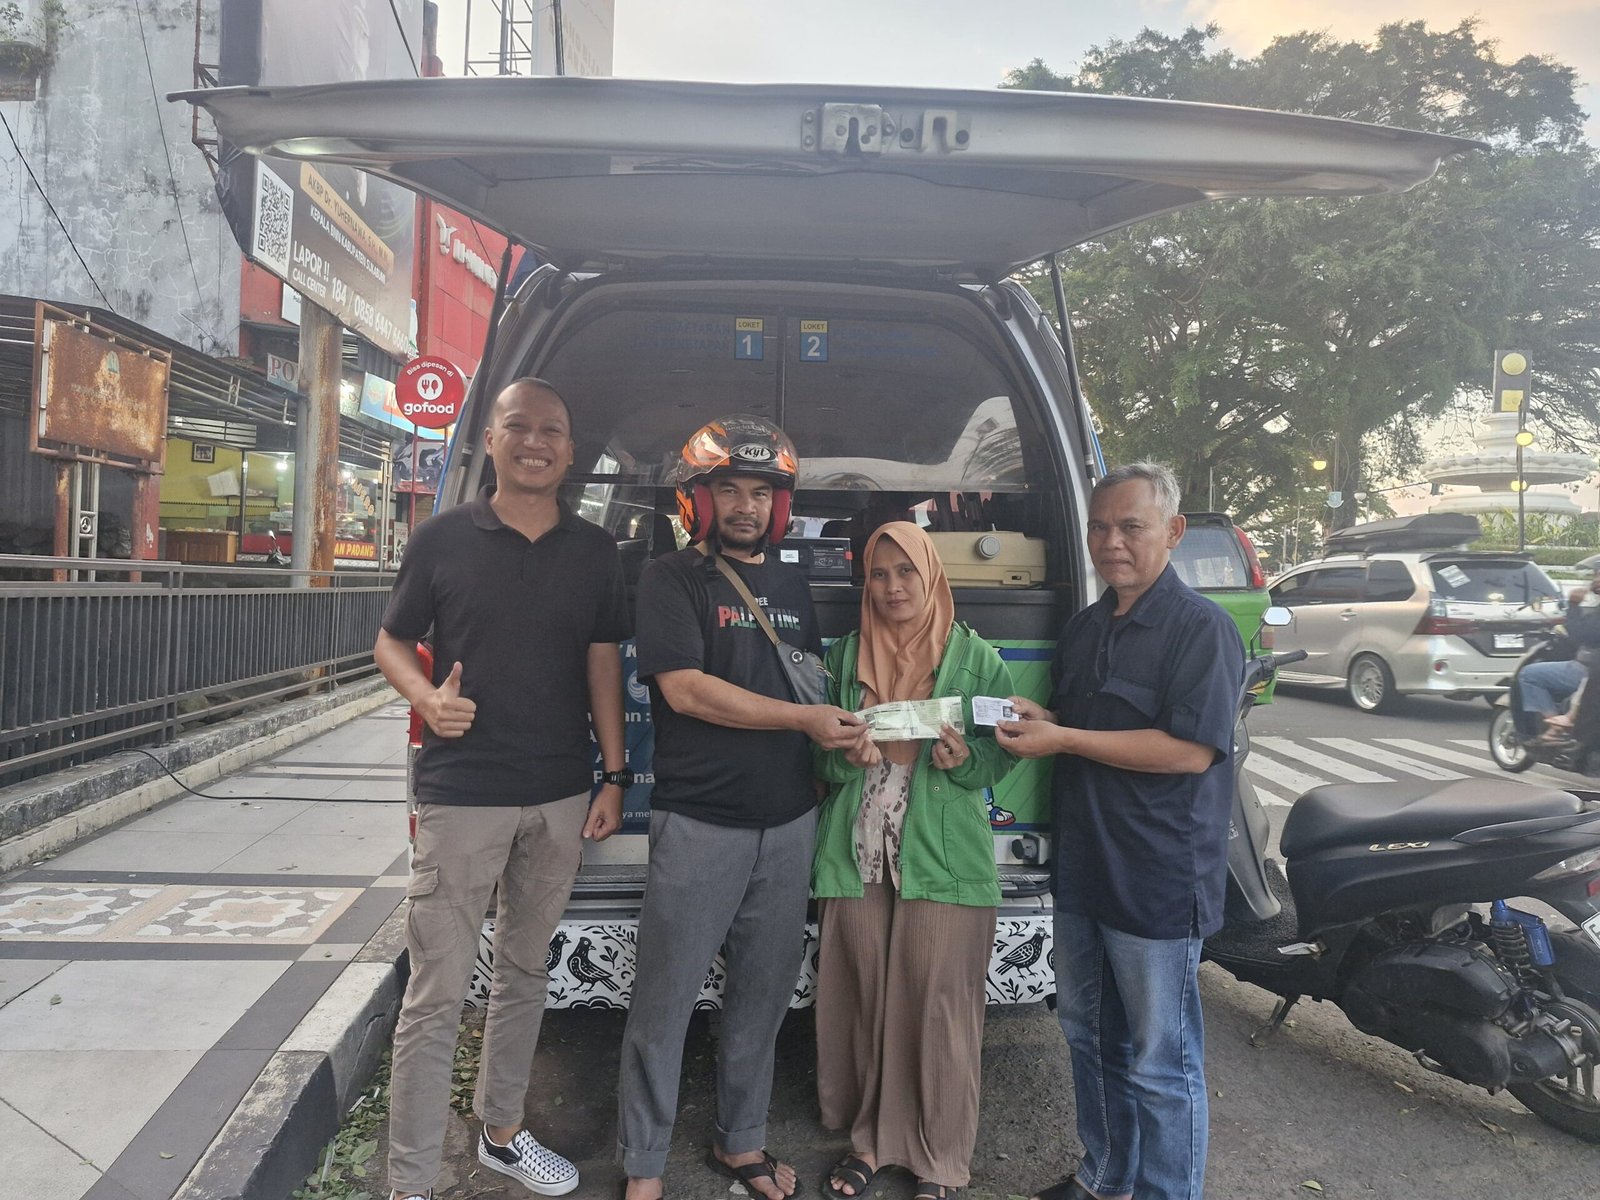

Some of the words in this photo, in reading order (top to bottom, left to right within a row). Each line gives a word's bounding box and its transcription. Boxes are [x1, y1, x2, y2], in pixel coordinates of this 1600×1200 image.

[310, 203, 330, 233] KEPALA
[341, 236, 366, 269] KABUPATEN
[293, 239, 323, 279] LAPOR
[292, 267, 306, 287] CALL
[306, 276, 327, 299] CENTER
[332, 276, 348, 307] 184
[354, 294, 374, 327] 0858
[375, 312, 392, 340] 6447
[738, 321, 760, 329] LOKET
[742, 334, 752, 356] 1
[807, 335, 820, 357] 2
[406, 363, 421, 376] Bisa
[421, 361, 448, 373] dipesan
[447, 369, 455, 377] di
[403, 401, 455, 416] gofood
[346, 543, 374, 558] PADANG
[718, 605, 801, 631] PALETINE
